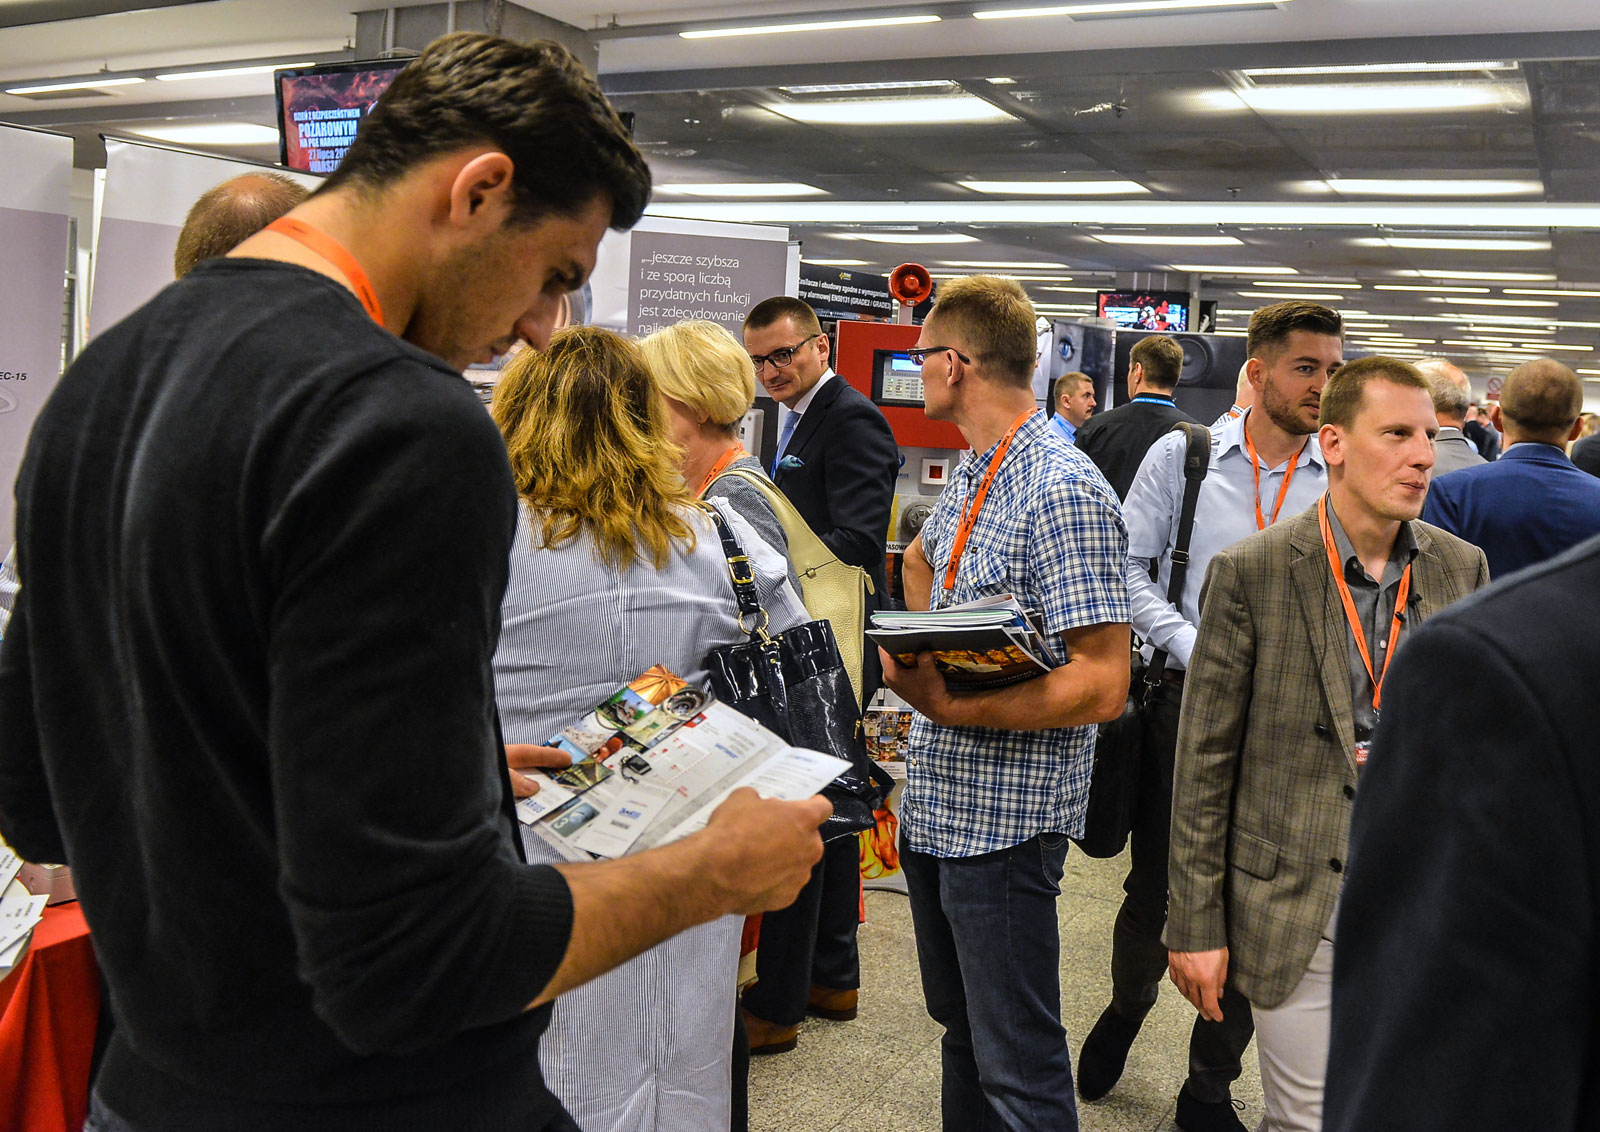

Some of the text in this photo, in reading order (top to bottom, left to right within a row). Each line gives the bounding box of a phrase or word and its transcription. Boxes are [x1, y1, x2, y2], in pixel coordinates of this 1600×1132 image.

[298, 120, 357, 138] POŻAROWYM
[695, 254, 740, 269] szybsza
[640, 267, 732, 289] i ze sporą liczbą
[639, 287, 751, 307] przydatnych funkcji
[637, 304, 745, 321] jest zdecydowanie
